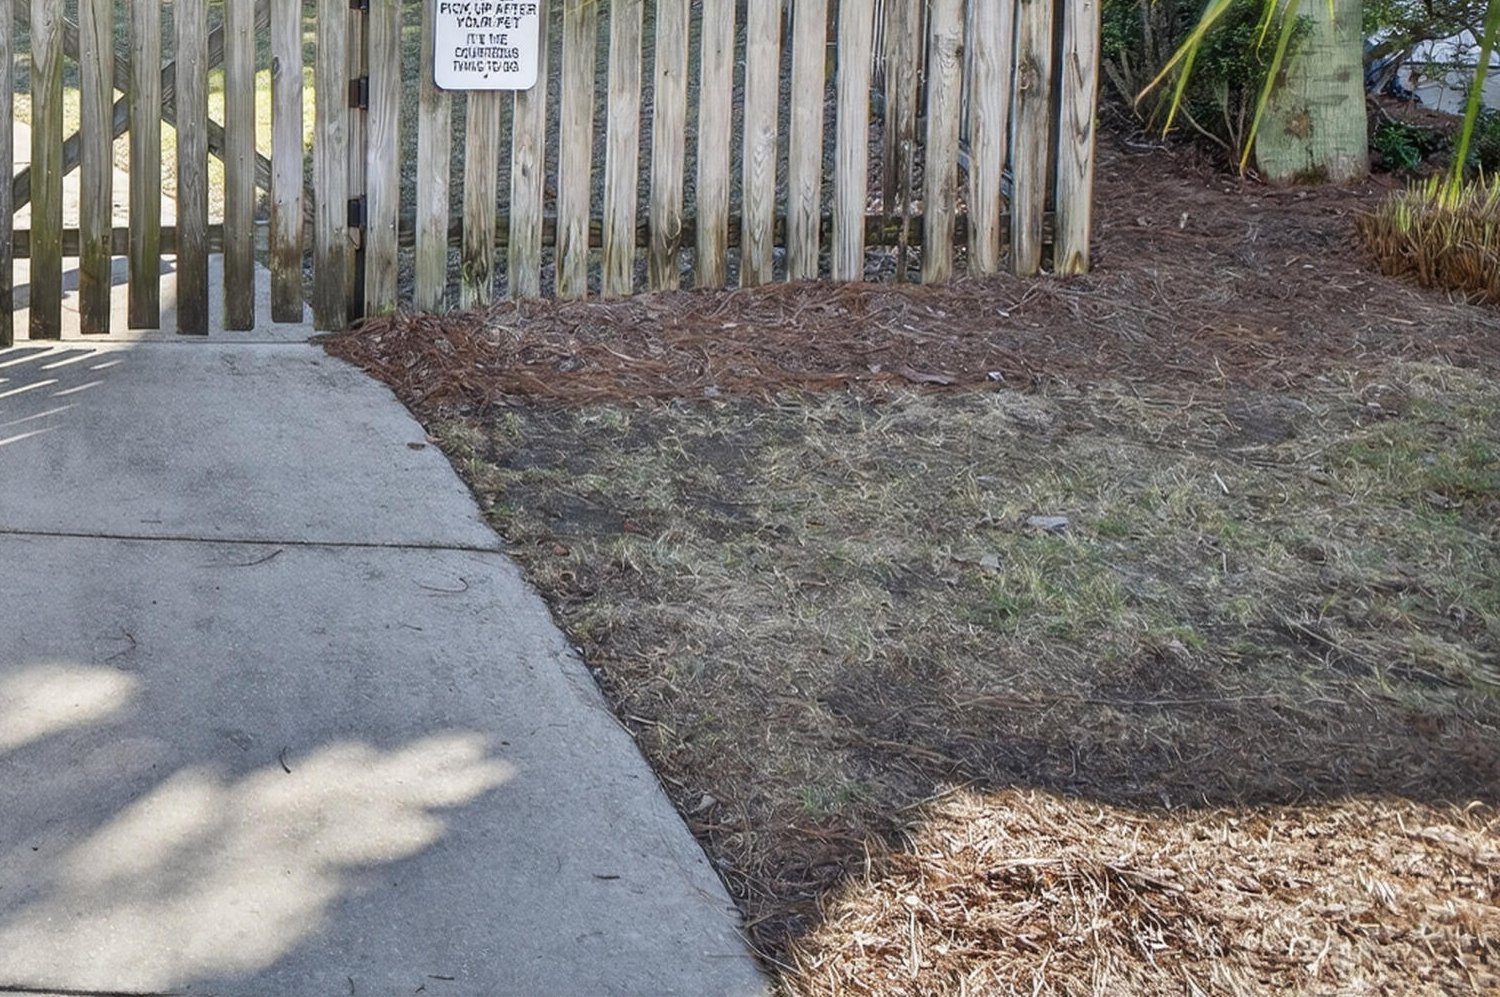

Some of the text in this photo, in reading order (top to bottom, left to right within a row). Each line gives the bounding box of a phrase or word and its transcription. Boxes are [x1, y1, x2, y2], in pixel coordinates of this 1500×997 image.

[440, 2, 537, 16] PICK UP AFTER
[456, 16, 522, 29] YOUR PET
